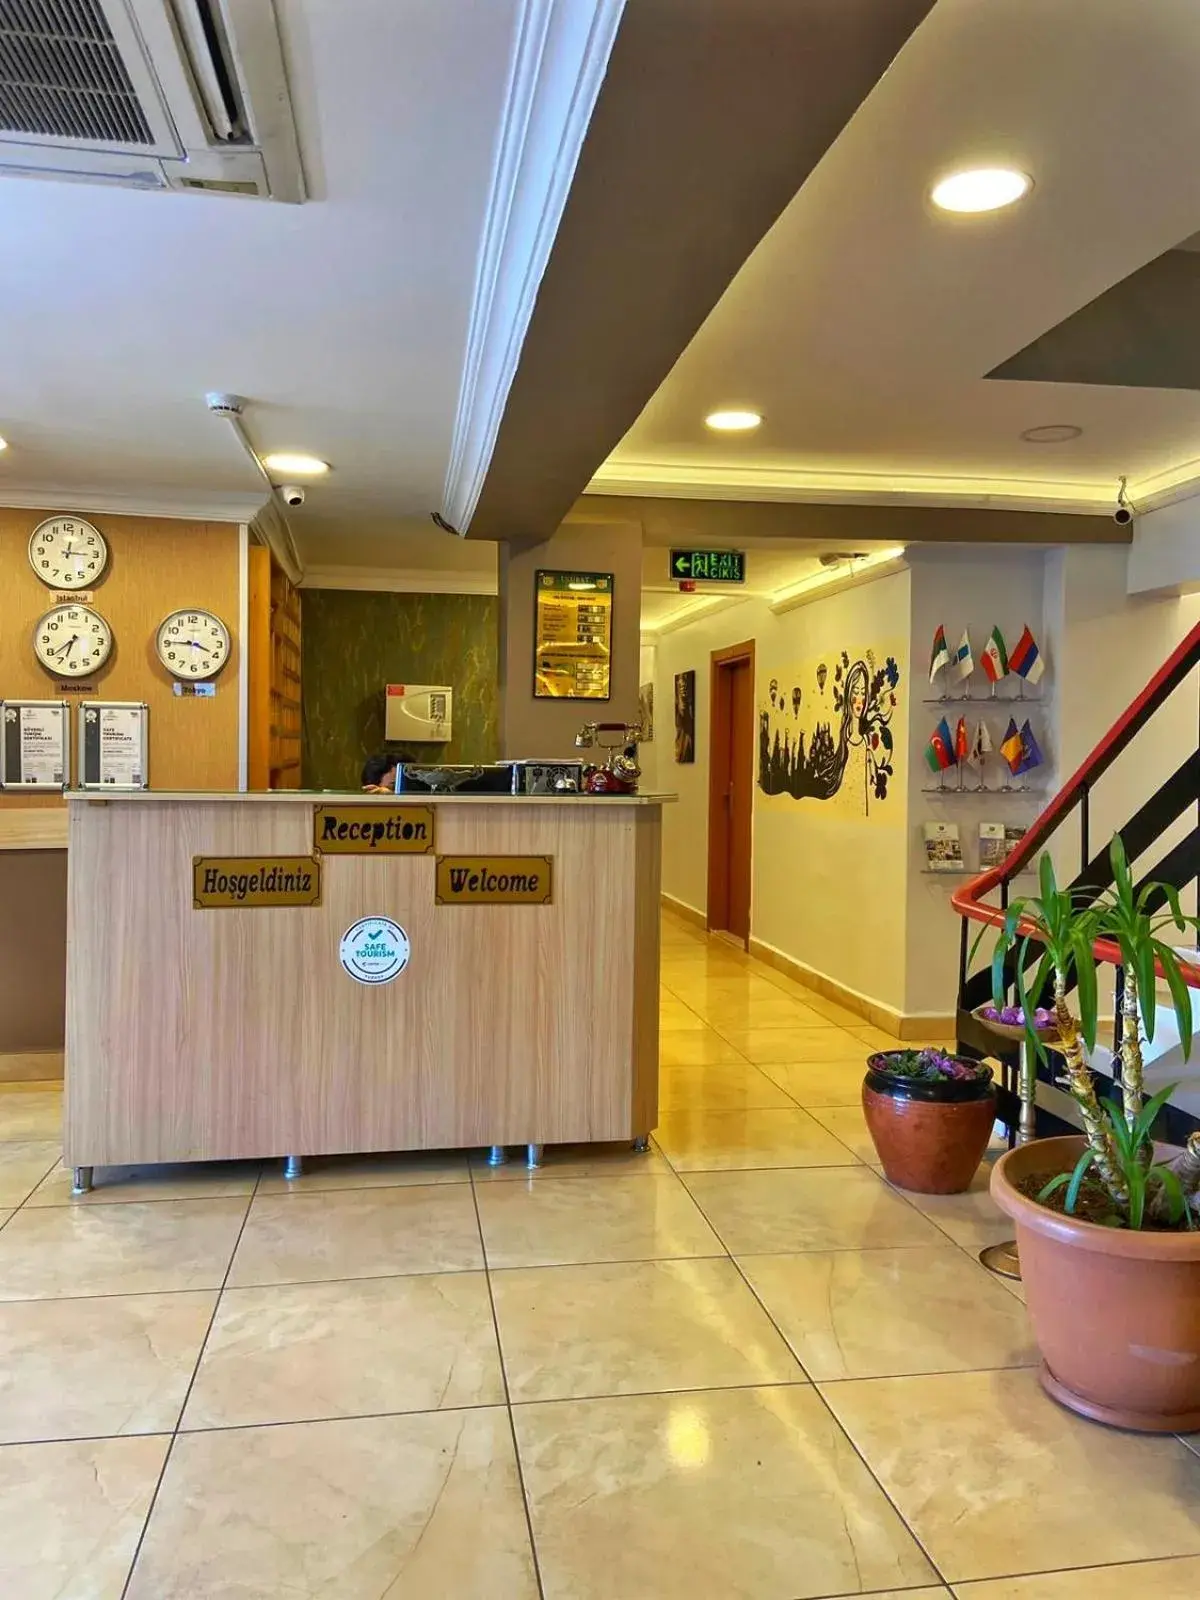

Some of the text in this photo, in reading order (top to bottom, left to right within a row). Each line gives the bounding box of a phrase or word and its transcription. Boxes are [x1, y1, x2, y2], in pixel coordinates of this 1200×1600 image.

[43, 534, 53, 542] 10
[87, 537, 94, 545] 2
[37, 547, 45, 555] 9
[710, 553, 740, 566] EXIT
[42, 560, 49, 568] 8
[52, 569, 59, 577] 7
[58, 615, 63, 623] 11
[92, 625, 99, 633] 2
[164, 640, 171, 648] 9
[47, 648, 54, 656] 8
[168, 652, 175, 660] 8
[57, 657, 64, 665] 7
[69, 661, 77, 669] 6
[82, 658, 90, 666] 5
[202, 661, 209, 669] 5
[191, 664, 197, 672] 6
[321, 815, 427, 847] Reception
[202, 866, 312, 900] Hoşgeldiniz
[449, 867, 539, 893] Welcome
[364, 943, 387, 951] SAFE
[355, 950, 395, 958] TOURISM
